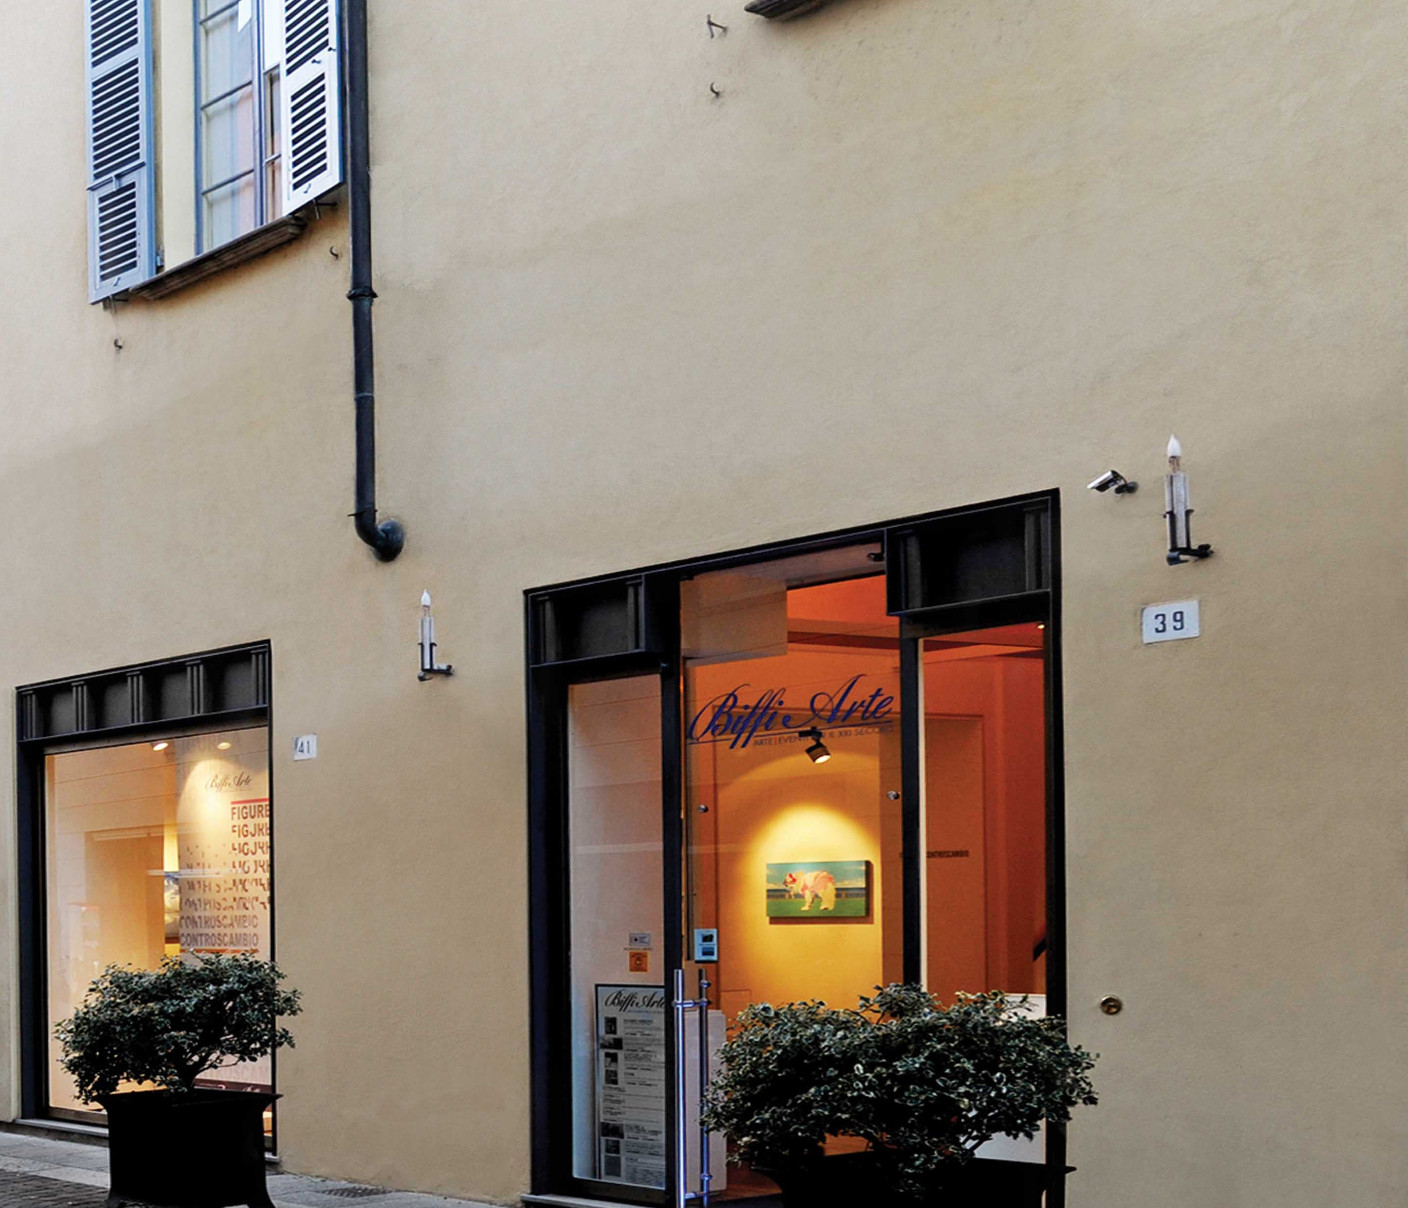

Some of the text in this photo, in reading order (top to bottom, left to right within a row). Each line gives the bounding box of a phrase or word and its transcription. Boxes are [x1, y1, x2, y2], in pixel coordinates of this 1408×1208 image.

[1154, 610, 1185, 634] 39
[688, 673, 895, 750] Biffi Arte
[230, 804, 270, 821] FIGURE
[180, 932, 259, 948] CONTROSCAMBIO
[604, 989, 638, 1012] Biffi
